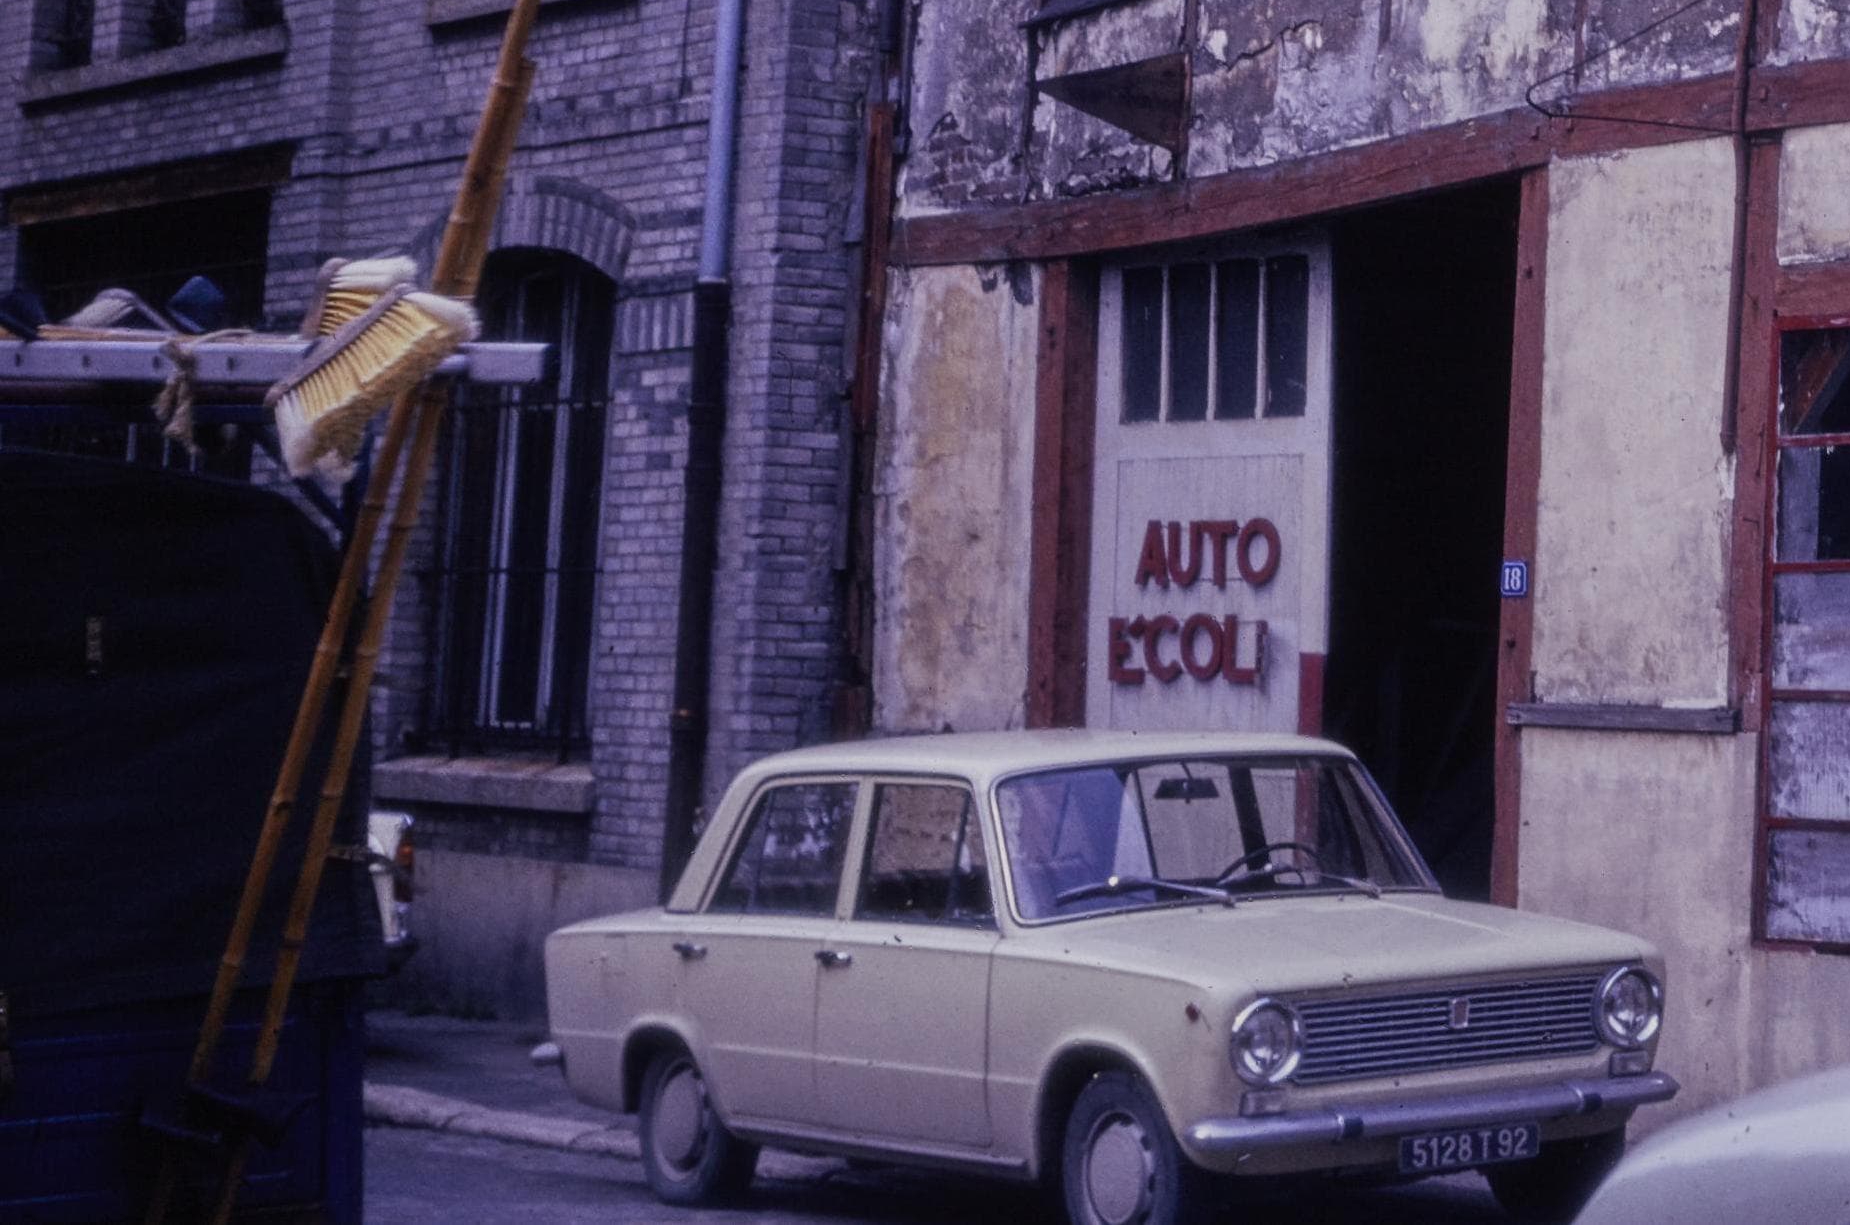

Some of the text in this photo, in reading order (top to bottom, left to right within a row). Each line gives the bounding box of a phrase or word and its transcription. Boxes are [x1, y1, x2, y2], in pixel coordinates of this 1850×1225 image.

[1134, 517, 1283, 591] AUTO
[1503, 566, 1521, 591] 18
[1107, 613, 1269, 686] ECOL
[1412, 1127, 1528, 1168] 5128 T 92
